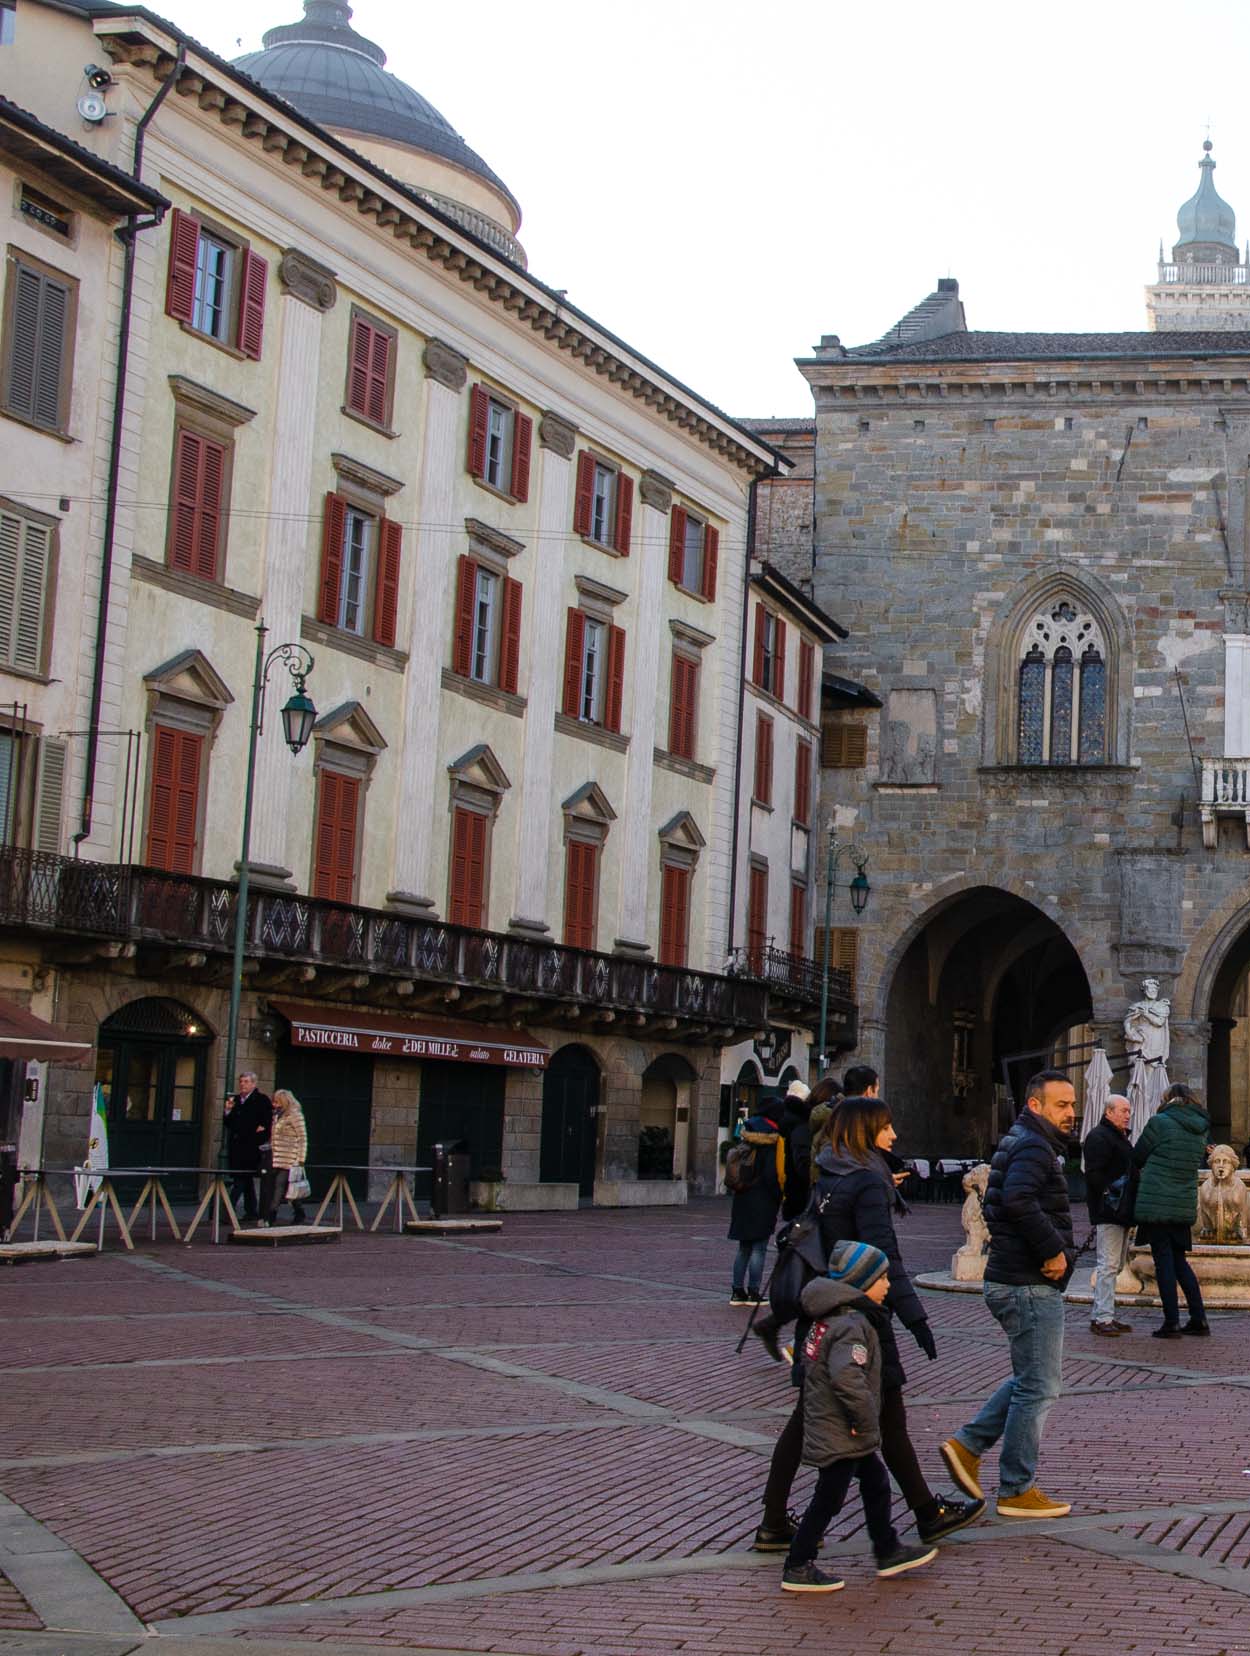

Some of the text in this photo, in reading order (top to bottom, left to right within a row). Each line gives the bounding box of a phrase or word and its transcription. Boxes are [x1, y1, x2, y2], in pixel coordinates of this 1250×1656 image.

[298, 1028, 358, 1047] PASTICCERIA
[372, 1037, 392, 1050] dolce
[411, 1040, 426, 1054] DEI
[428, 1042, 452, 1057] MILLE
[504, 1049, 544, 1065] GELATERIA
